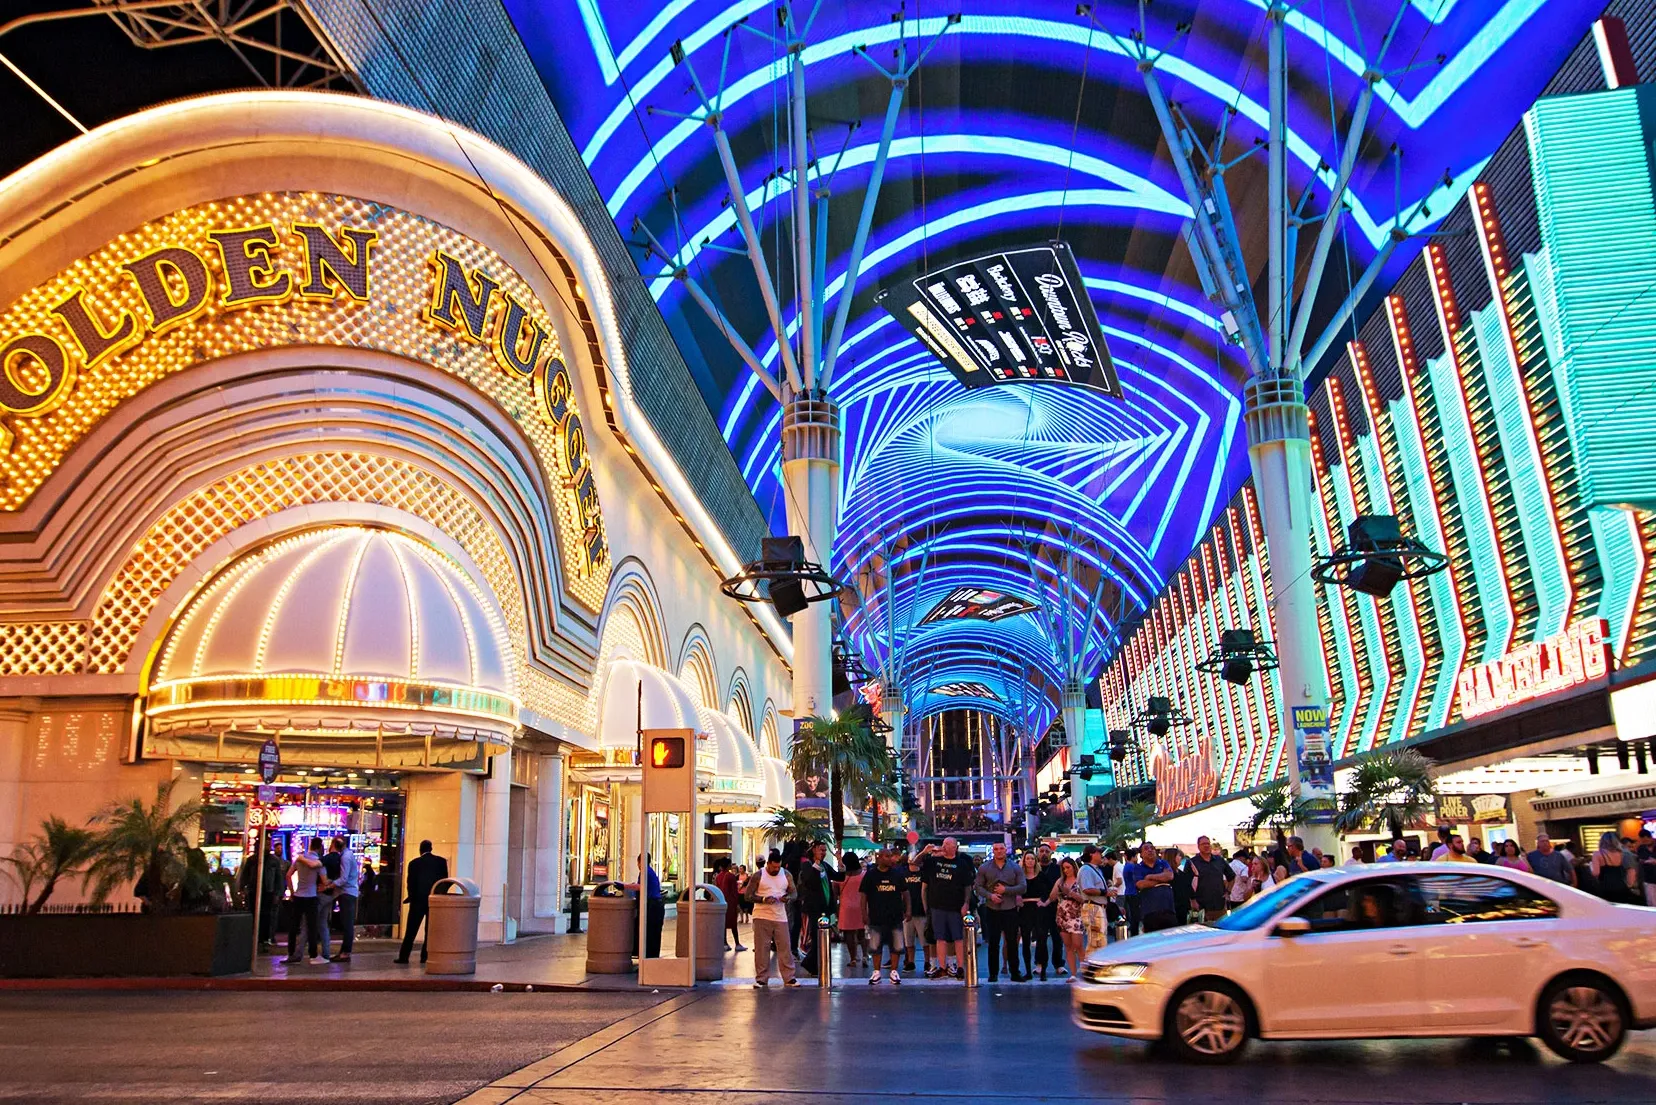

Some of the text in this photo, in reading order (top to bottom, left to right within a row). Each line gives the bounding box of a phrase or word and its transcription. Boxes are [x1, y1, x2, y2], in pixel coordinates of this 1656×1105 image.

[1034, 273, 1073, 331] Downtown
[0, 223, 378, 456] OLDEN
[1458, 615, 1608, 721] GAMBLING
[1295, 709, 1327, 722] NOW
[1442, 796, 1463, 807] LIVE
[1439, 806, 1468, 817] POKER
[876, 884, 896, 892] VIRGIN
